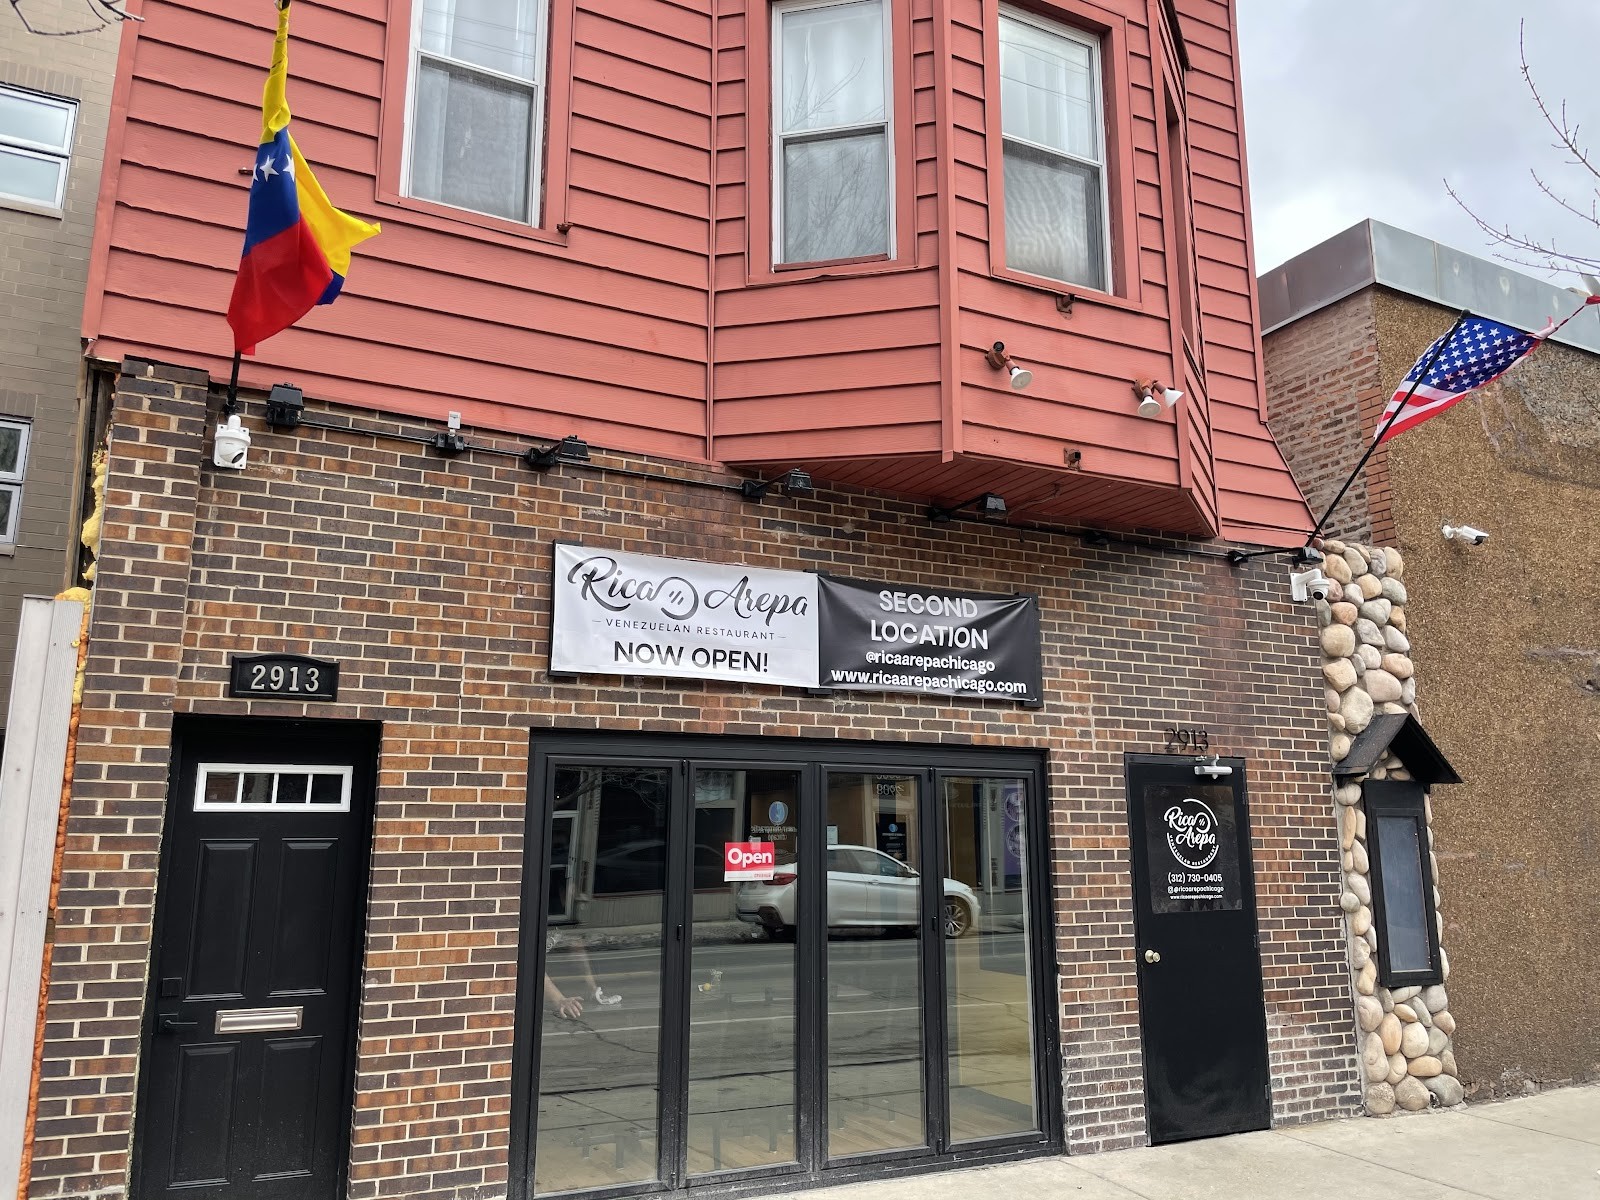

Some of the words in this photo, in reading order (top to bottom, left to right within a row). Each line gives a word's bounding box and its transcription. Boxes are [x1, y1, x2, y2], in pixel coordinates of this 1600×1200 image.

[567, 556, 657, 612] Rica
[704, 576, 808, 627] Arepa
[879, 590, 978, 618] SECOND
[606, 618, 691, 633] VENEZUELAN
[697, 626, 775, 640] RESTAURANT
[870, 619, 989, 650] LOCATION
[614, 640, 684, 666] NOW
[691, 648, 768, 673] OPEN!
[866, 650, 995, 675] @ricaarepachicago
[250, 664, 320, 692] 2913
[830, 669, 1027, 694] www.ricaarepachicago.com
[1165, 728, 1209, 752] 2913
[1163, 806, 1196, 832] Rica
[1175, 826, 1216, 851] Arepa
[727, 847, 773, 868] Open
[1168, 872, 1186, 884] (312)
[1186, 873, 1223, 883] 730-0405
